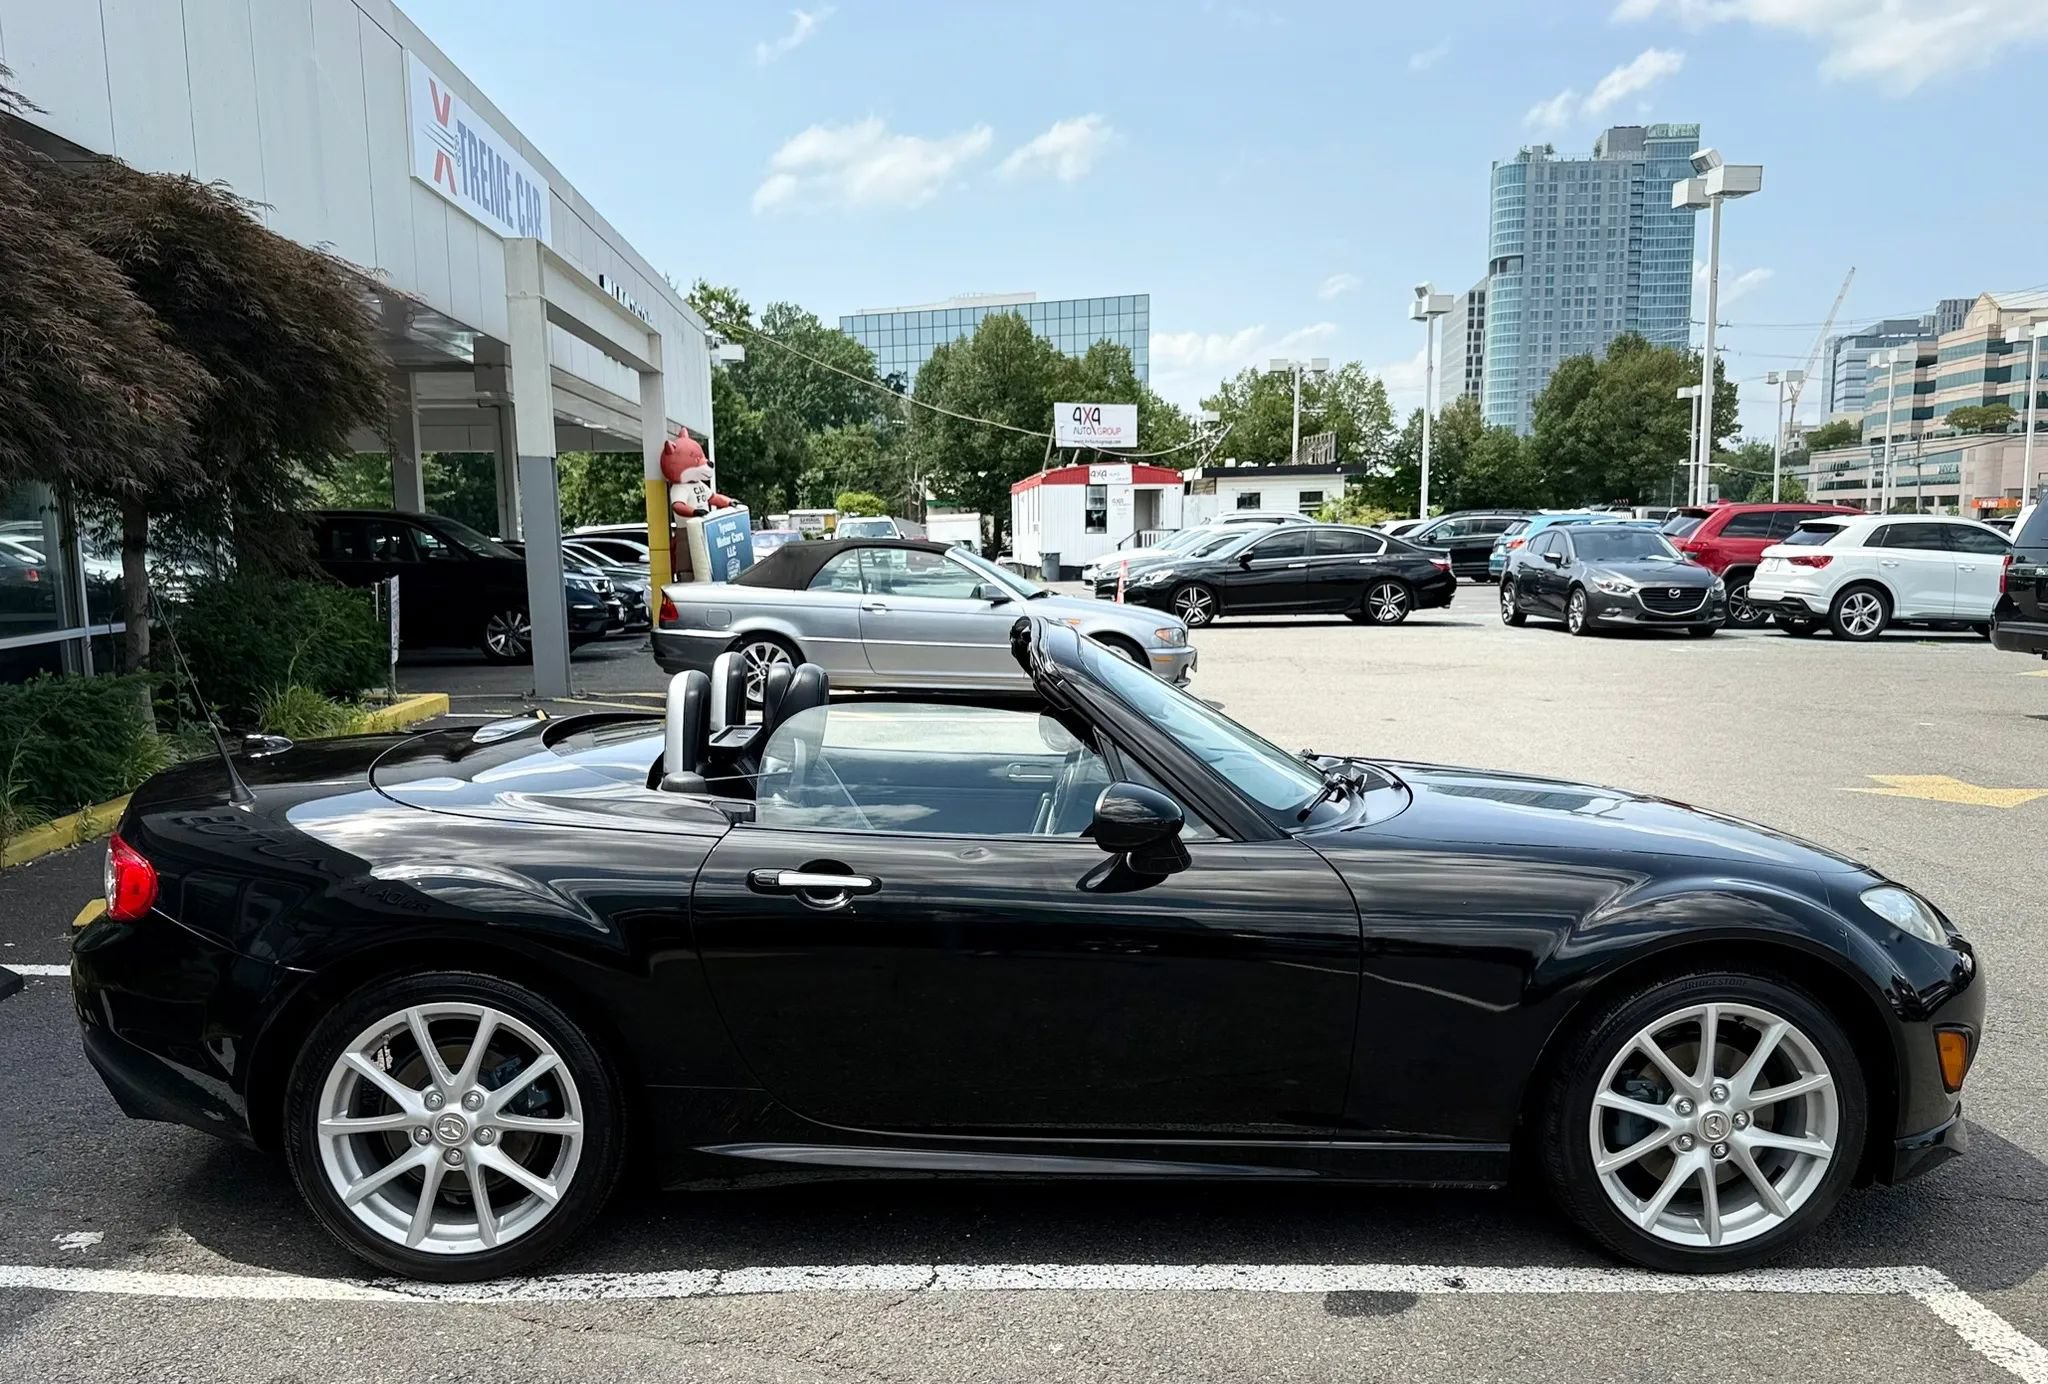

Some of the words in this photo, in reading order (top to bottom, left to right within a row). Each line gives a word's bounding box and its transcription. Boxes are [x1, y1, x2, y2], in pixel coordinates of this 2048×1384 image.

[515, 171, 543, 240] CAR
[1073, 426, 1092, 435] AUTO
[1096, 426, 1122, 436] GROUP
[731, 532, 745, 544] Cars
[726, 545, 737, 558] LLC
